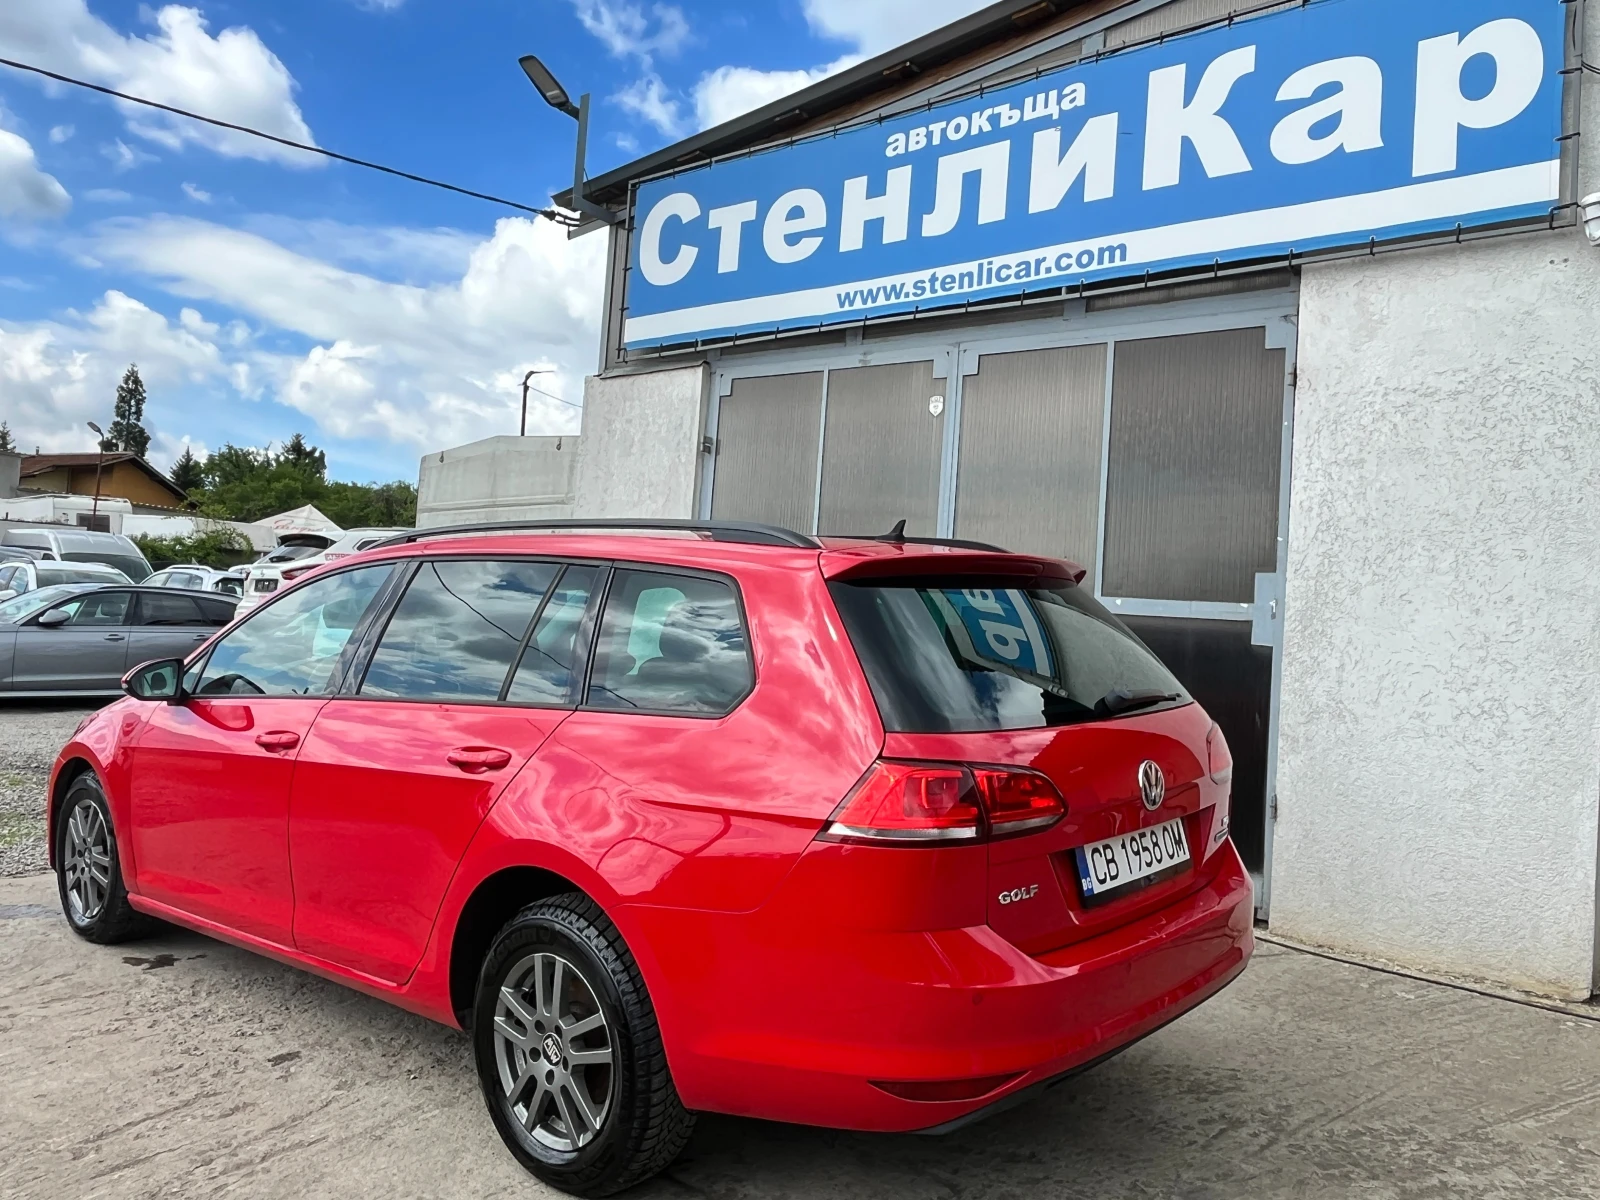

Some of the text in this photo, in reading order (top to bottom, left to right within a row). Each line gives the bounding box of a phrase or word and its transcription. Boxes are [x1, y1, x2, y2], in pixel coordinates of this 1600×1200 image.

[885, 82, 1086, 157] автокъща
[837, 243, 1127, 309] www.stenlicar.com
[1121, 829, 1163, 875] 1958
[998, 884, 1039, 905] GOLF
[1081, 877, 1093, 891] BG
